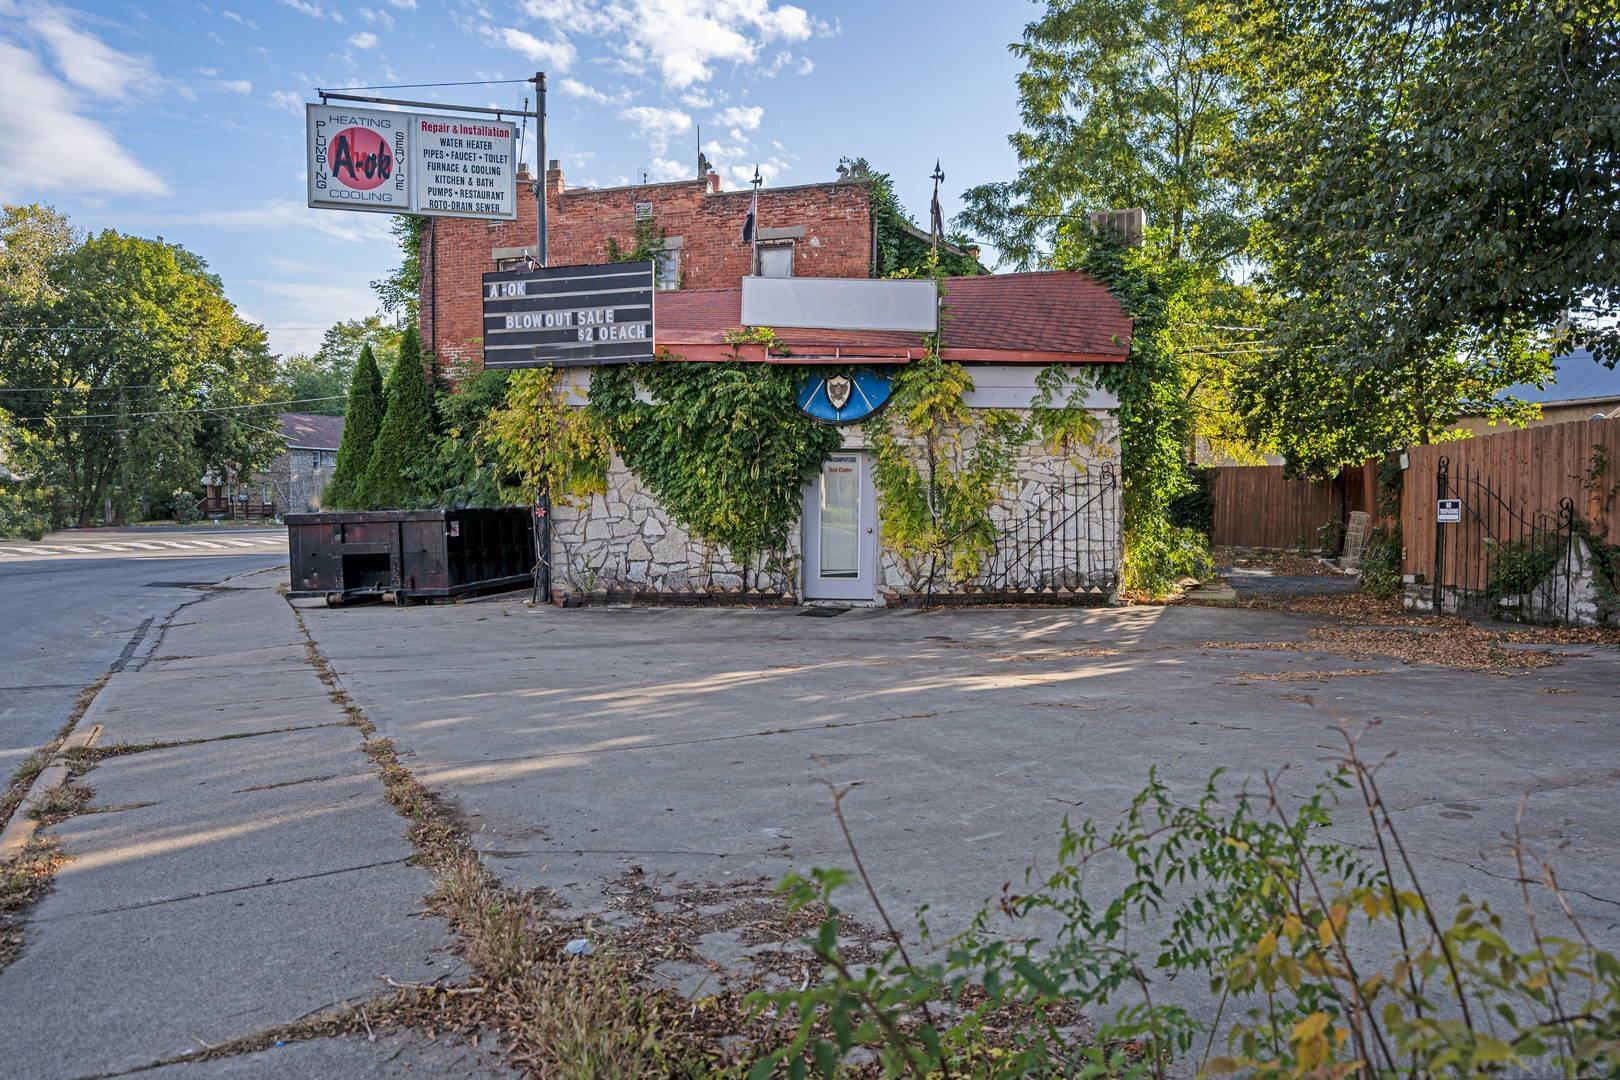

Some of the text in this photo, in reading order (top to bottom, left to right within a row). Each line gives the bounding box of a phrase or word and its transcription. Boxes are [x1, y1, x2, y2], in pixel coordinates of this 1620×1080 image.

[329, 115, 390, 128] HEATING
[422, 121, 509, 138] Repair & Installation
[440, 138, 492, 150] WATER HEATER
[316, 121, 326, 189] PLUMBING
[396, 132, 404, 190] SERVICE
[424, 149, 508, 164] PIPES FAUCET TOILET
[428, 162, 500, 175] FURNACE & COOLING
[435, 175, 494, 187] KITCHEN & BATH
[330, 190, 392, 202] COOLING
[428, 188, 504, 200] PUMPS RESTAURANT
[429, 200, 500, 212] ROTO-DRAIN SEWER
[506, 310, 614, 328] BLOW OUT SALE
